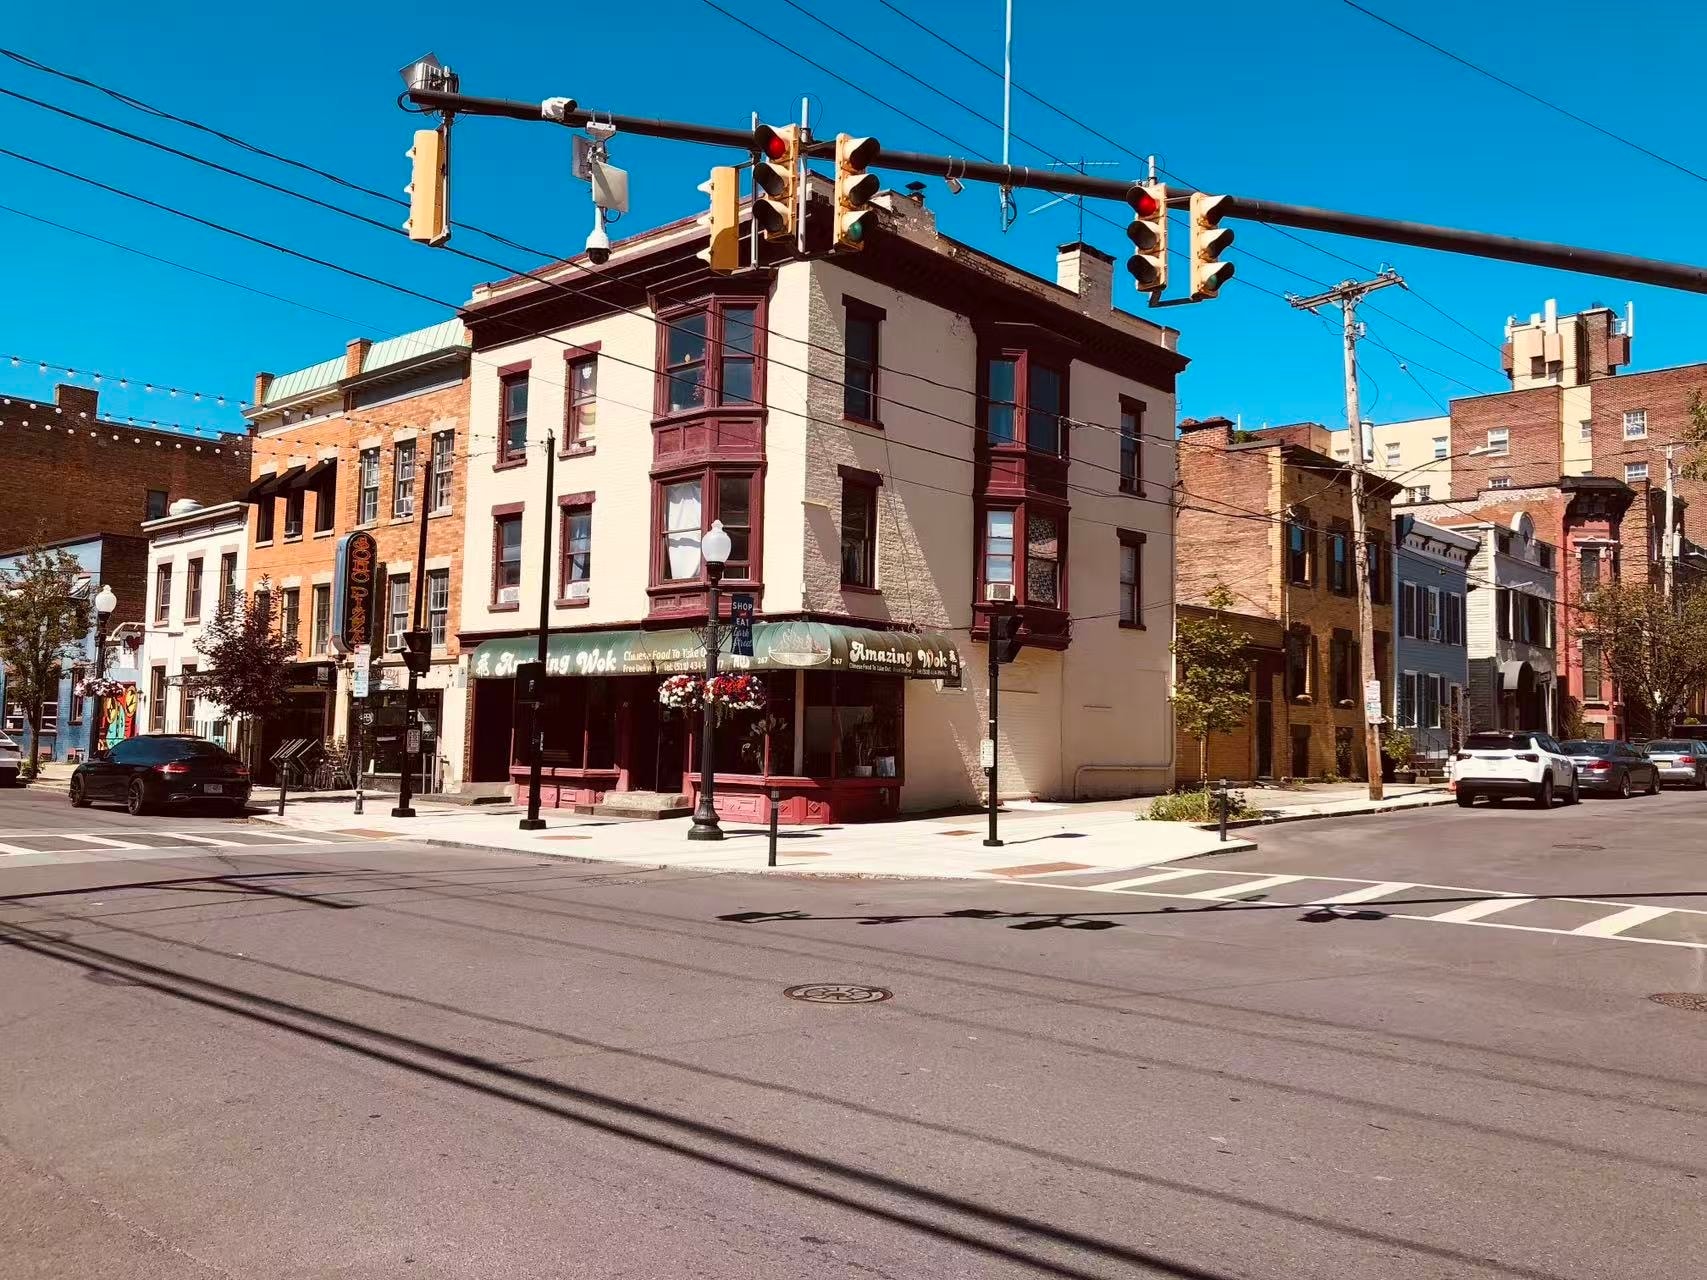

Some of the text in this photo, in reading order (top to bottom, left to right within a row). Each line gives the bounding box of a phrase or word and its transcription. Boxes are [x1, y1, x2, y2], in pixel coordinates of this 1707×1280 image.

[351, 536, 371, 583] SOHO
[732, 601, 752, 611] SHOP
[736, 618, 749, 627] EAT
[653, 649, 671, 660] Food
[672, 649, 681, 659] To
[682, 647, 699, 658] Take
[849, 640, 912, 667] Amazing
[917, 649, 947, 668] Wok
[576, 649, 616, 676] Wok
[622, 664, 635, 673] Free
